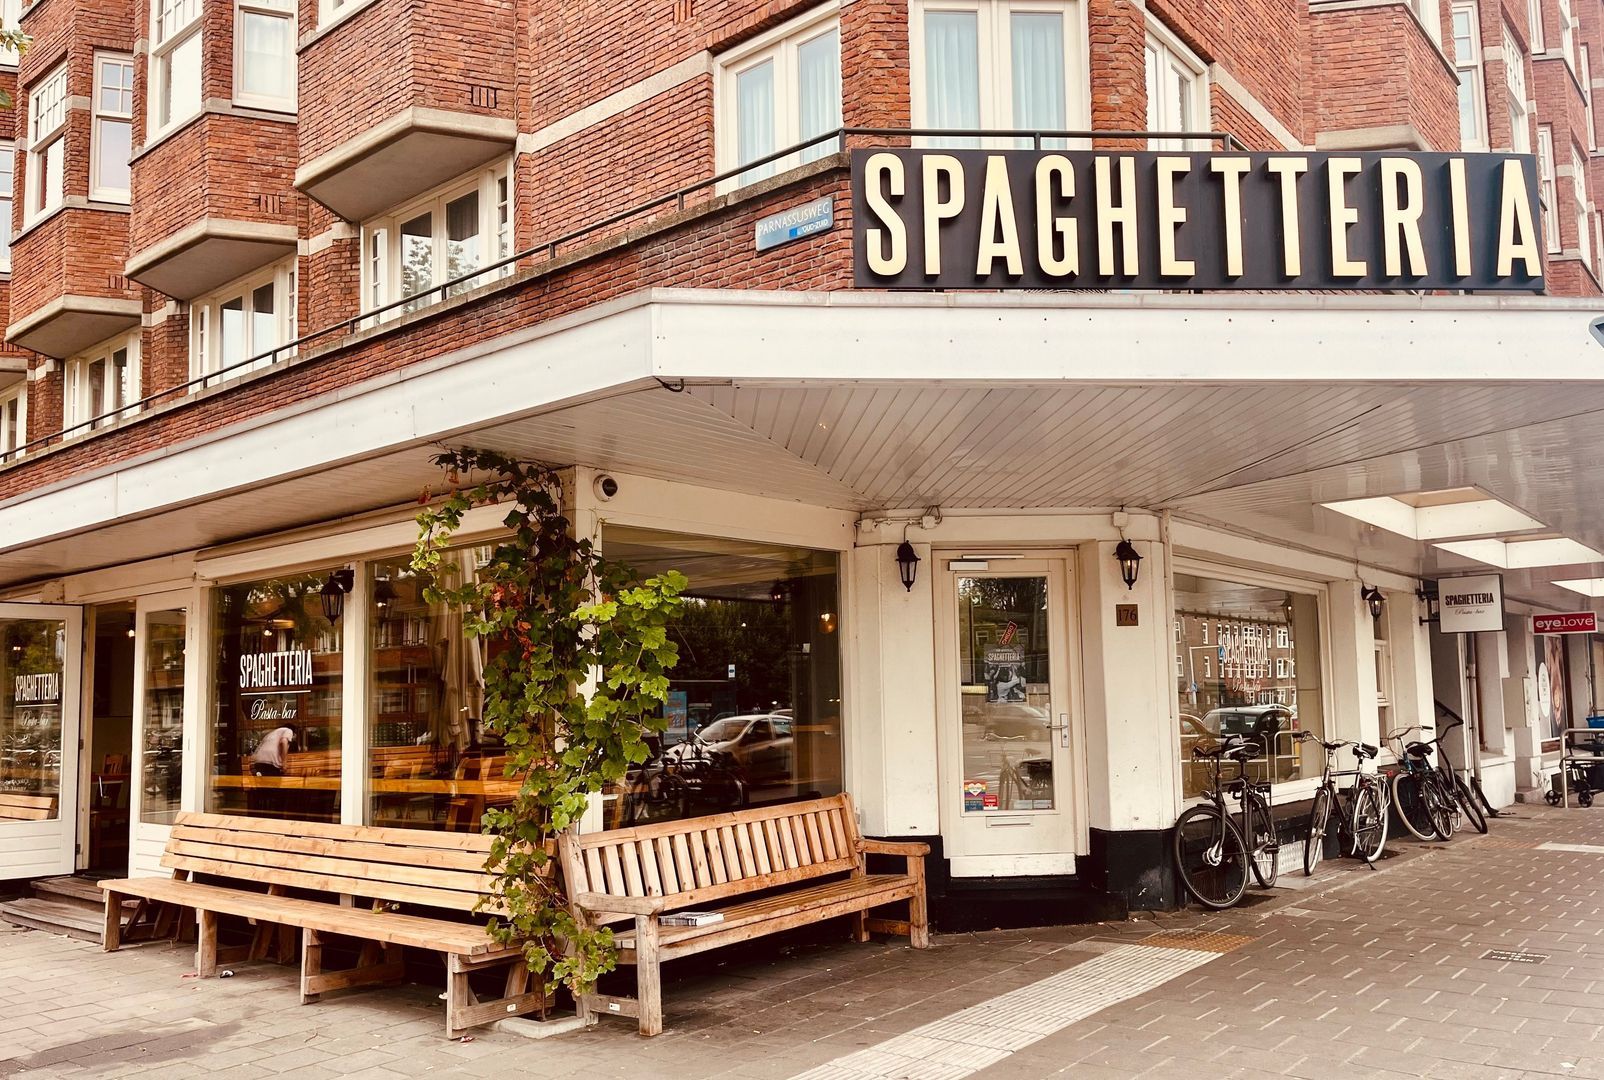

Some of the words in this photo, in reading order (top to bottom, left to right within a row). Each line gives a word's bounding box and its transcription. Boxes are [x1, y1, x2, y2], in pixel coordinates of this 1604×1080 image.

[758, 202, 829, 236] PARNASSUSWEG
[864, 152, 1542, 277] SPAGHETTERIA
[1445, 592, 1494, 606] SPAGHETTERIA
[1118, 608, 1137, 622] 176
[1535, 616, 1594, 631] eyelove
[987, 652, 1020, 662] SPAGHETTERIA
[1223, 634, 1268, 665] SPAGHETTERIA
[240, 649, 313, 689] SPAGHETTERIA
[15, 672, 59, 702] SPAGHETTERIA
[250, 699, 298, 720] Pasta-bar
